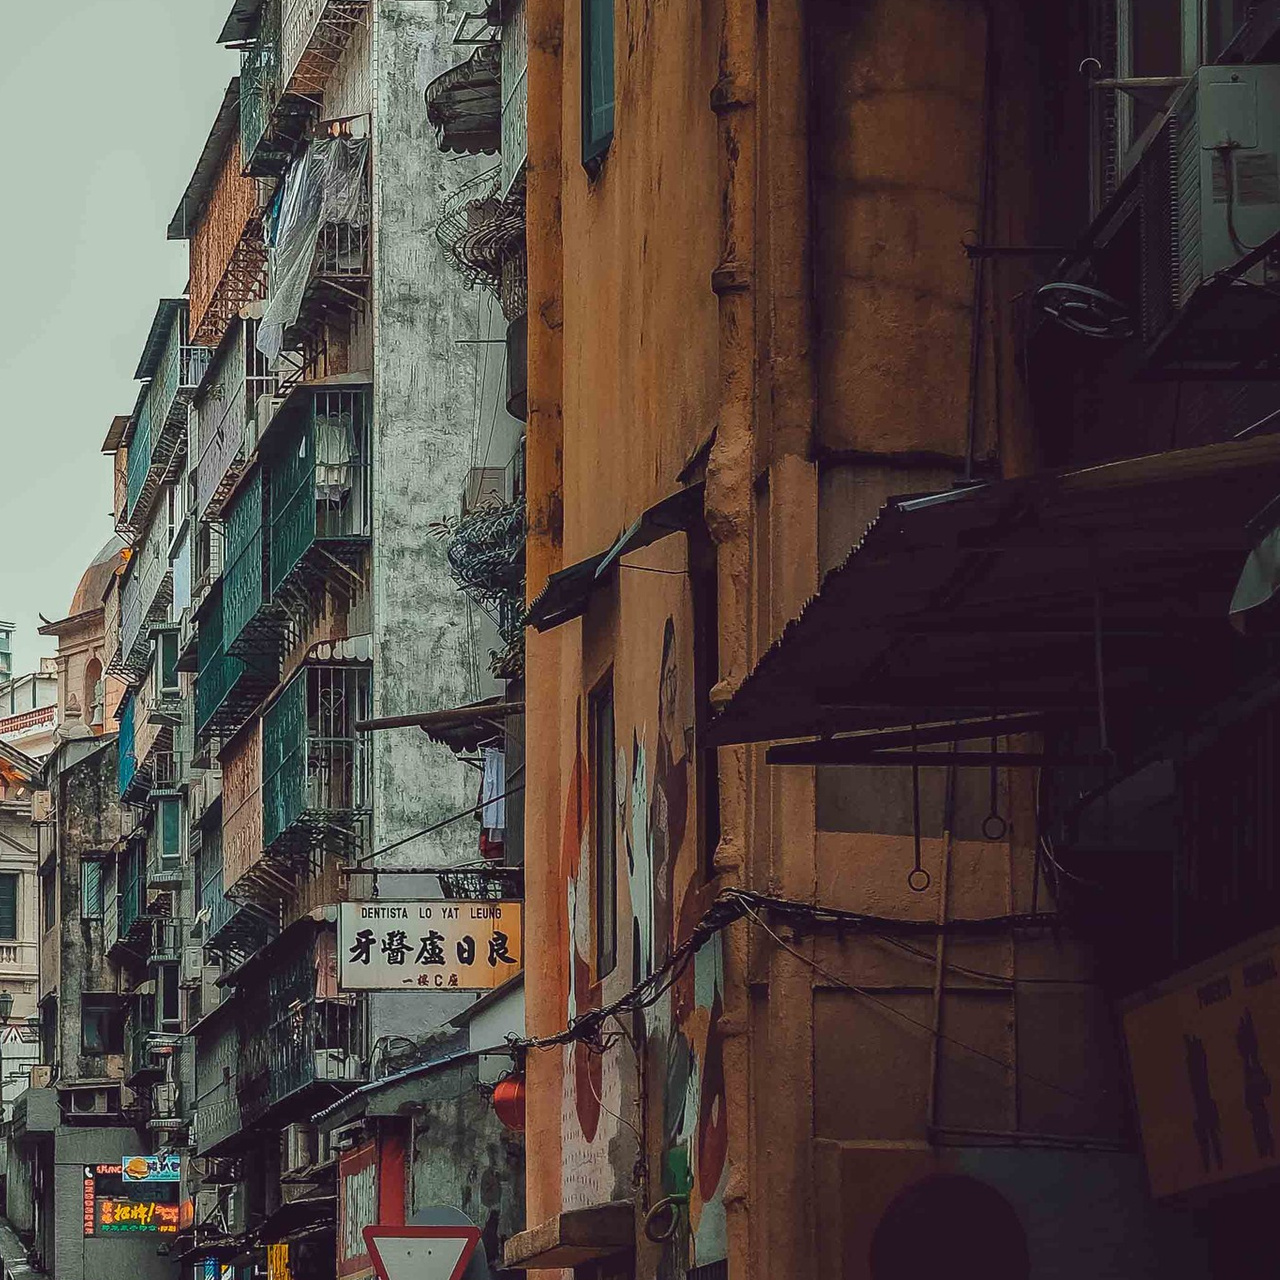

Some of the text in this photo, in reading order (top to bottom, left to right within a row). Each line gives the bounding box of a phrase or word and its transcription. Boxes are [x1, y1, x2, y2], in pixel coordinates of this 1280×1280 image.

[361, 907, 502, 919] DENTISTA LO YAT LEUNG
[348, 928, 518, 967] 牙醫盧日良
